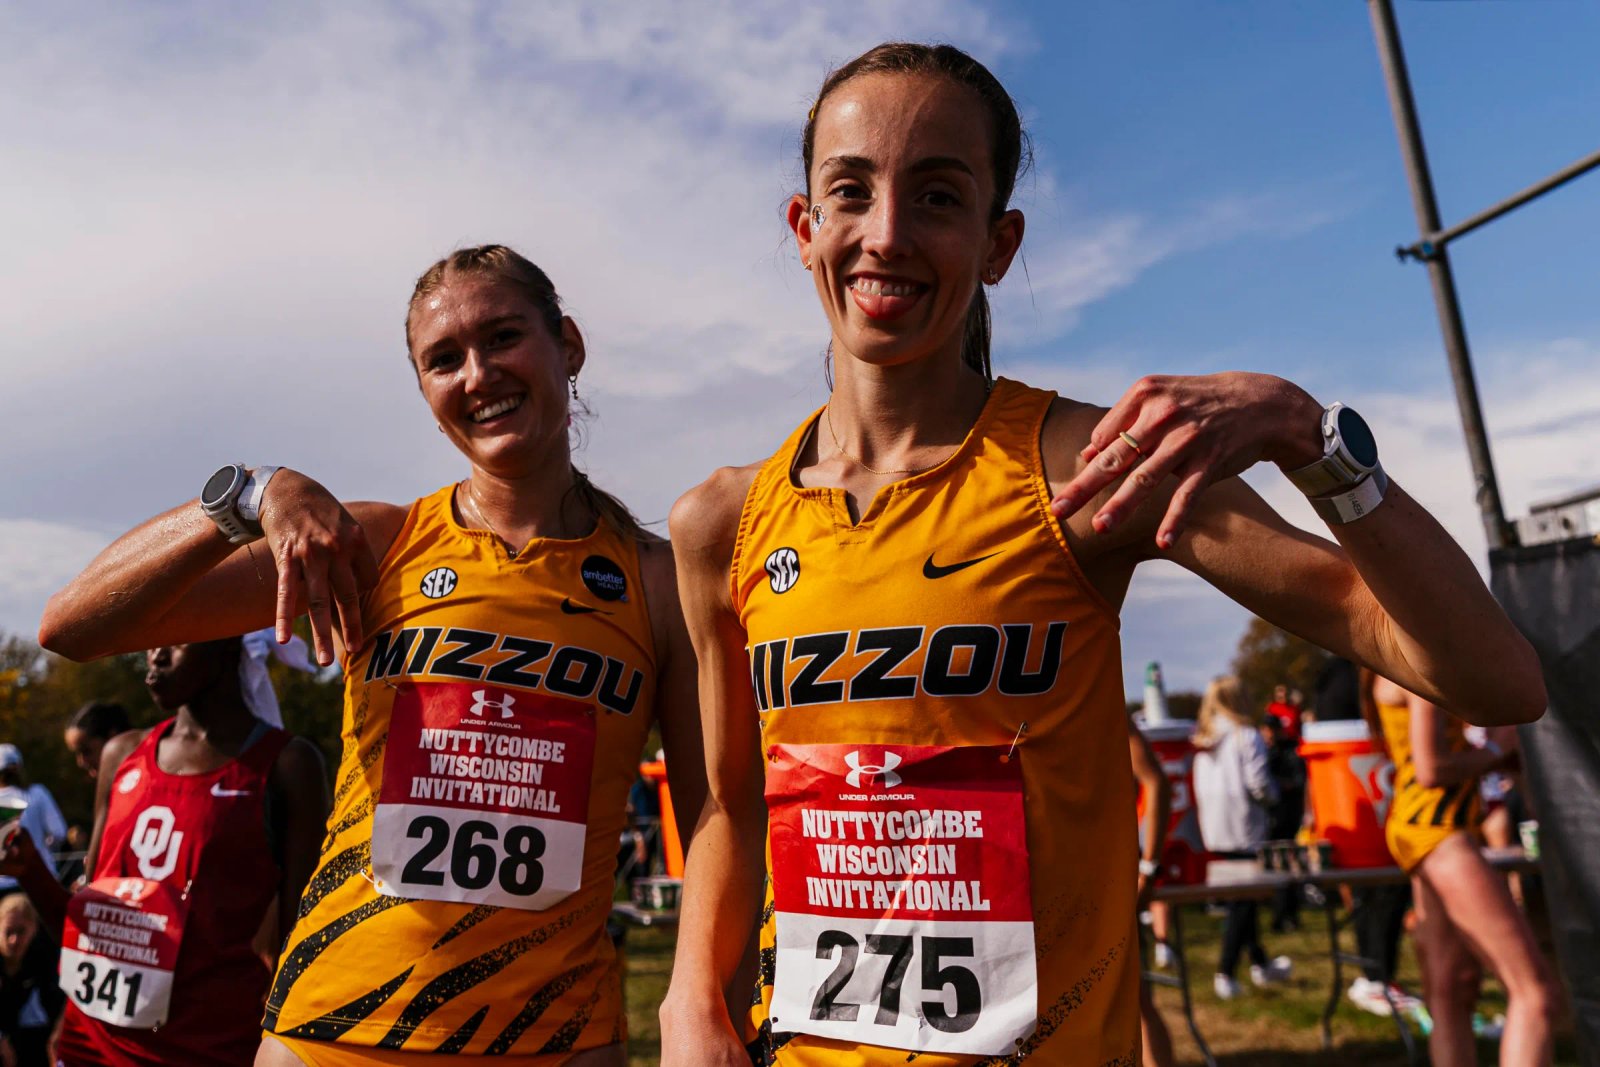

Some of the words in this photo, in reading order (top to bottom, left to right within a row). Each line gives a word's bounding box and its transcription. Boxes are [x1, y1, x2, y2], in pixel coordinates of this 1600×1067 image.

[421, 567, 457, 598] SEC
[583, 569, 625, 584] ambetter
[597, 581, 625, 591] HEALTH
[765, 548, 799, 593] SEC
[364, 627, 645, 717] MIZZOU
[460, 718, 487, 726] UNDER
[488, 721, 521, 730] ARMOUR
[418, 728, 566, 763] NUTTYCOMBE
[430, 752, 543, 786] WISCONSIN
[410, 777, 561, 814] INVITATIONAL
[838, 793, 868, 802] UNDER
[870, 793, 915, 802] ARMOUR
[801, 808, 984, 841] NUTTYCOMBE
[130, 805, 184, 881] OU
[401, 815, 547, 897] 268
[816, 843, 957, 876] WISCONSIN
[807, 875, 991, 912] INVITATIONAL
[83, 901, 169, 932] NUTTYCOMBE
[77, 933, 159, 966] INVITATIONAL
[88, 920, 152, 947] WISCONSIN
[75, 961, 144, 1018] 341
[809, 929, 982, 1034] 275
